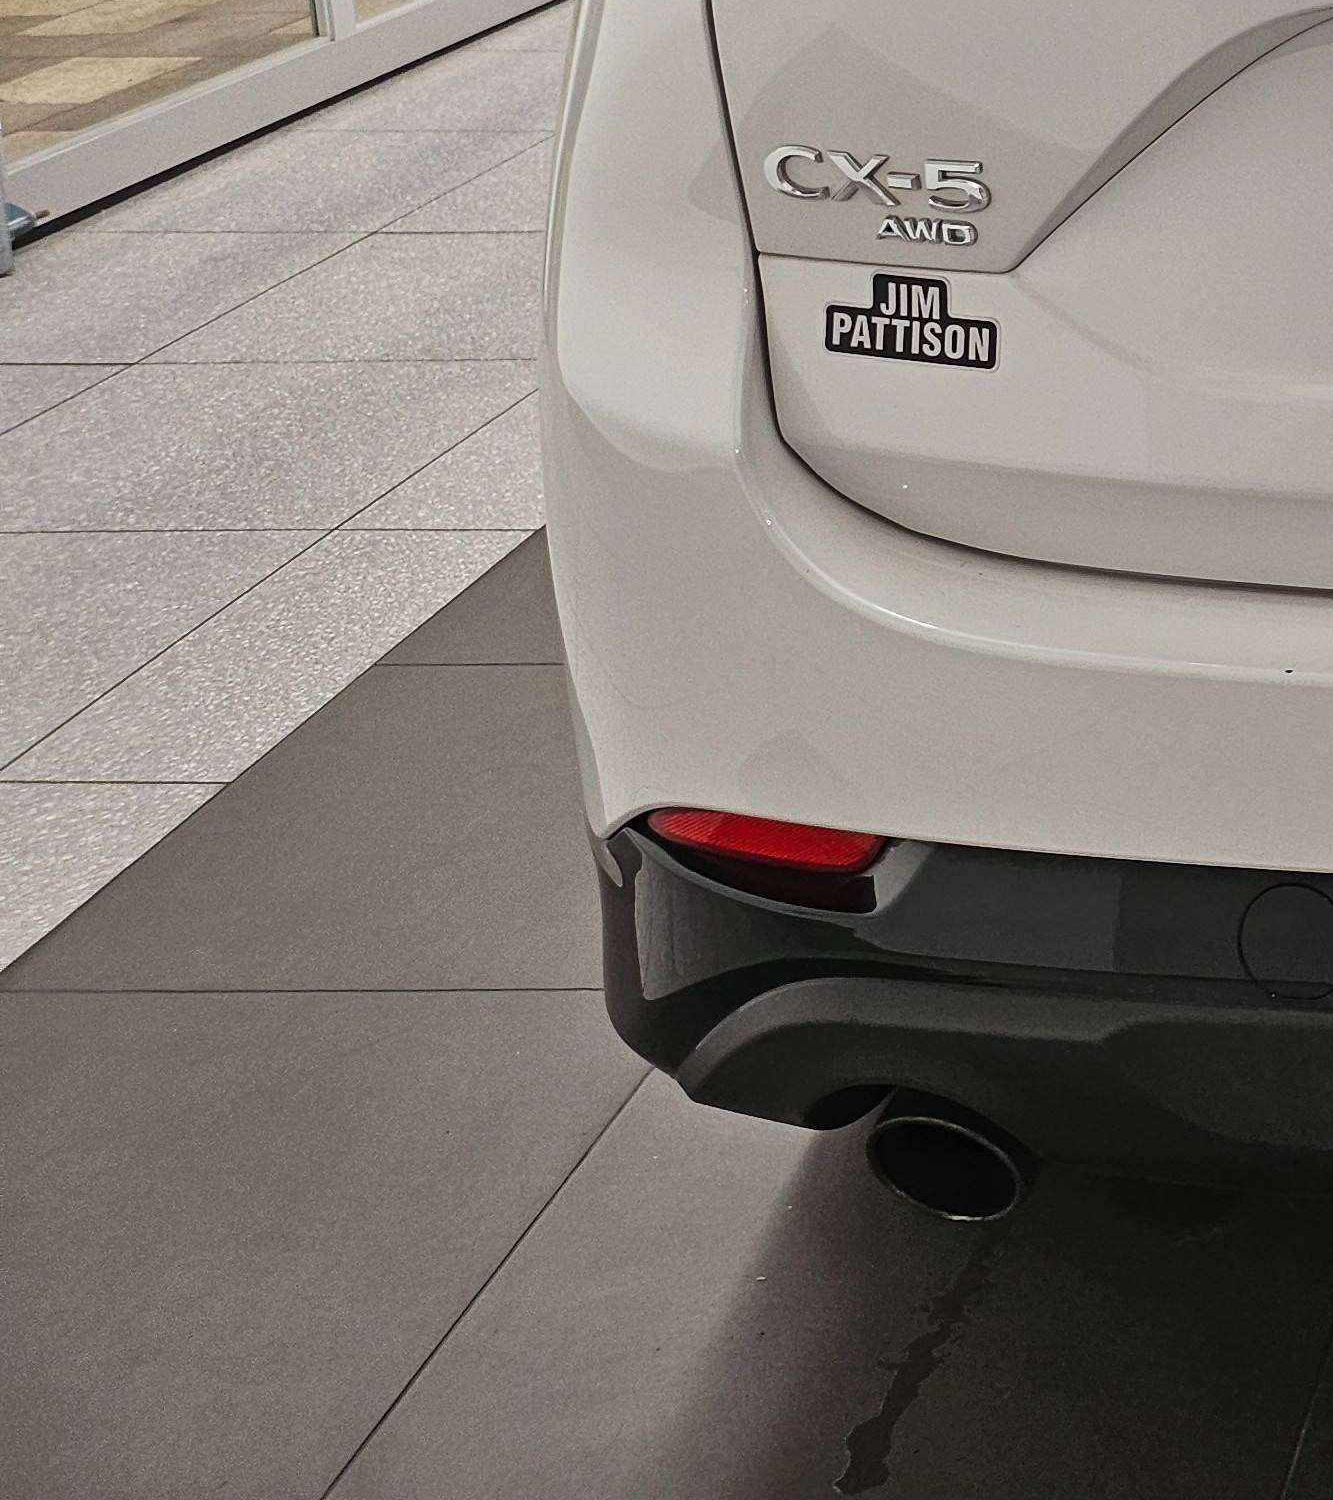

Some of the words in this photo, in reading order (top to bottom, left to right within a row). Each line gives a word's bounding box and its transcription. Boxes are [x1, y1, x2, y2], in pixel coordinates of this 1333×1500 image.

[763, 144, 992, 214] CX-5
[876, 214, 979, 246] AWD
[879, 281, 940, 320] JIM
[831, 311, 991, 362] PATTISON
